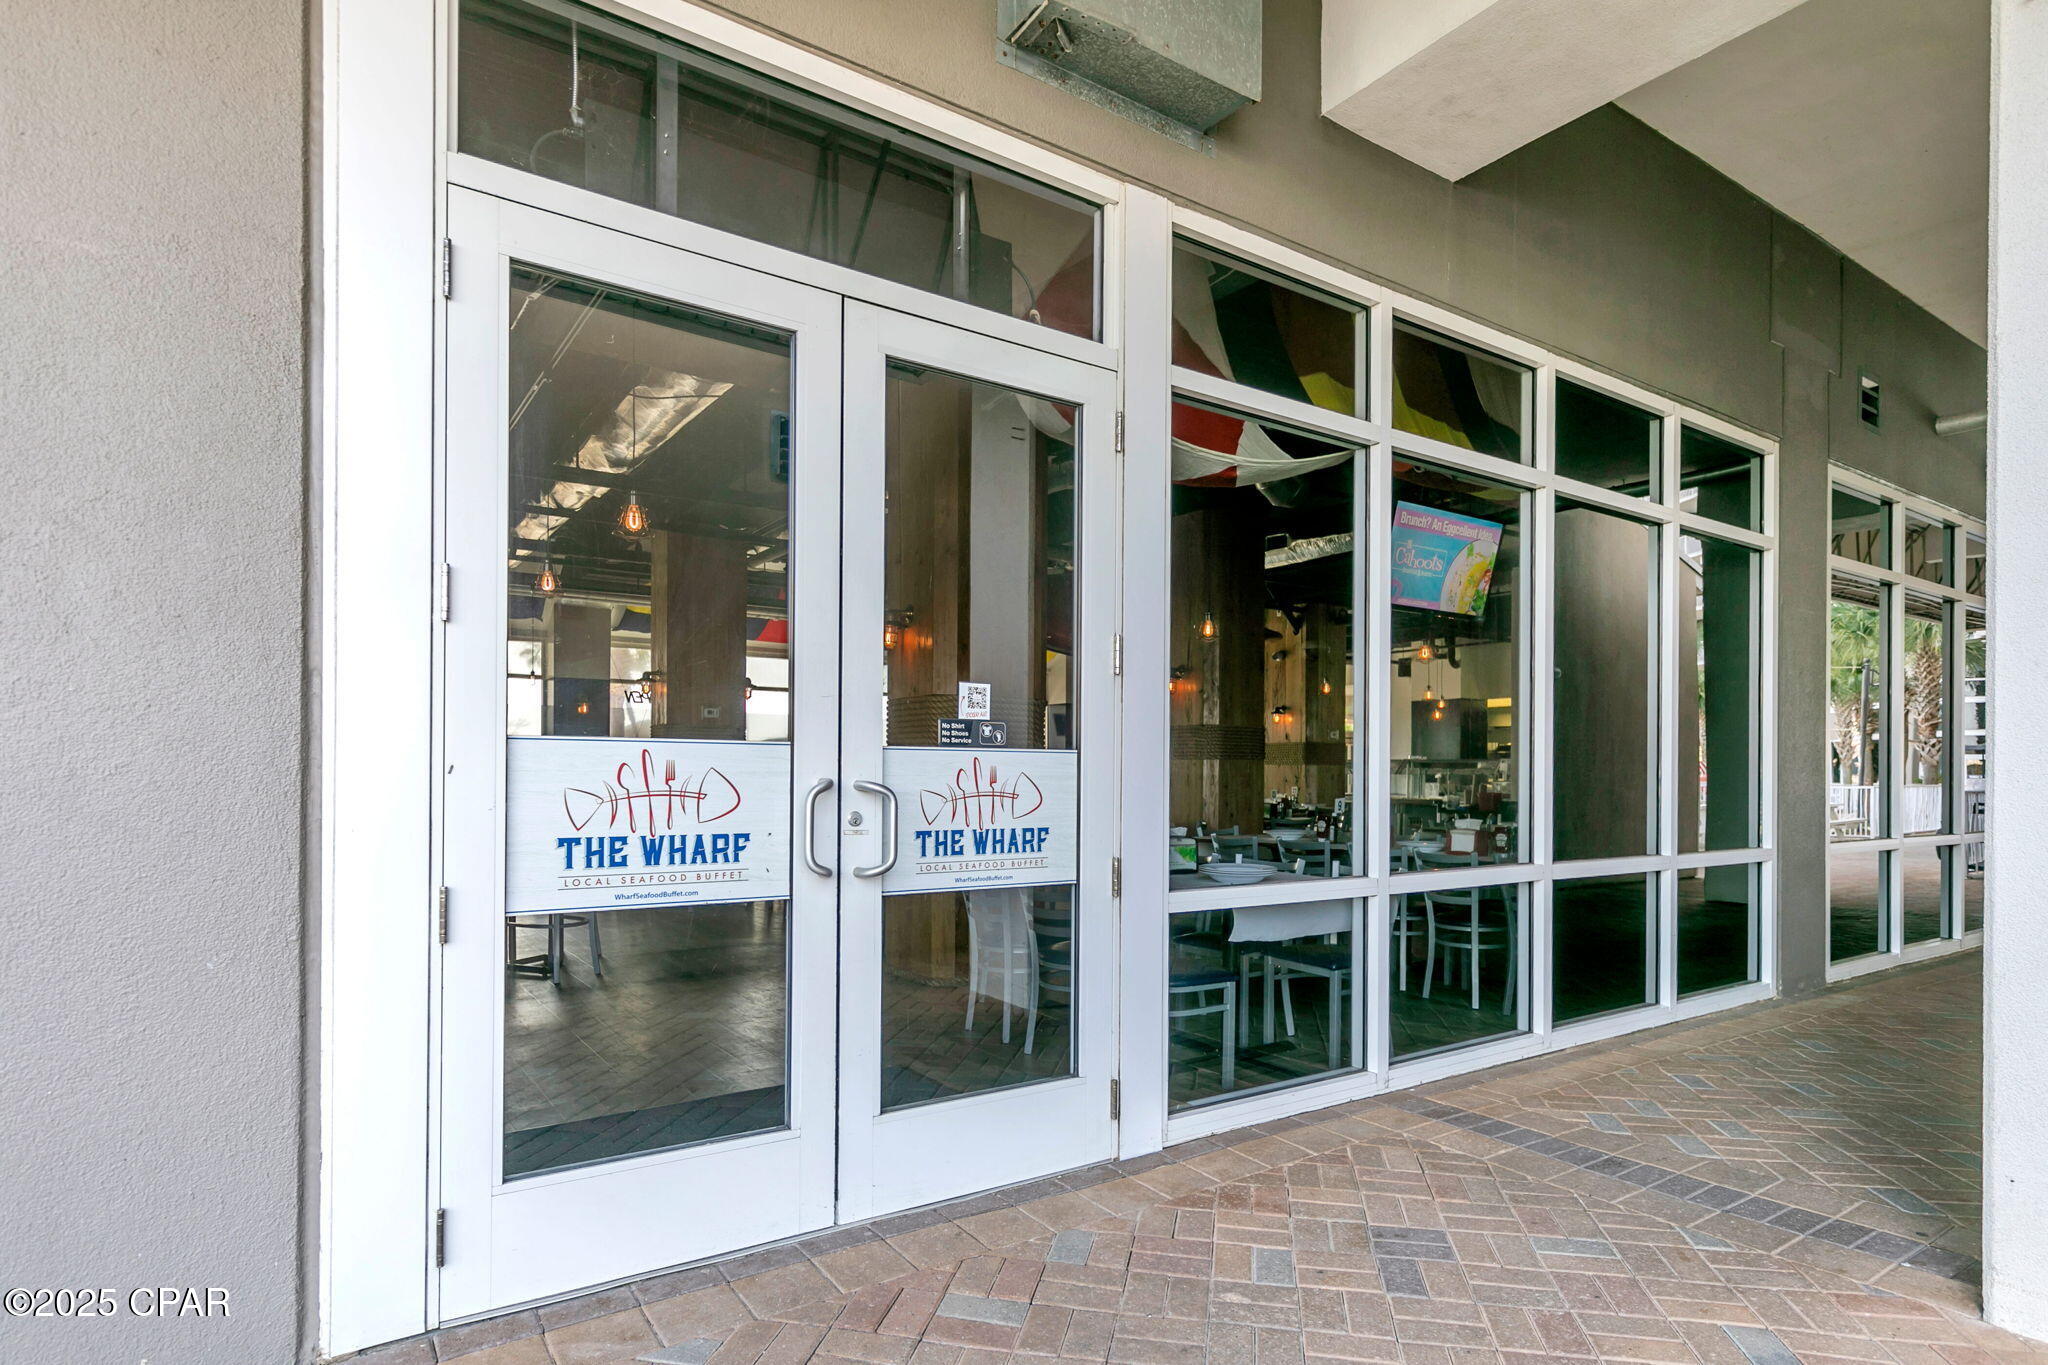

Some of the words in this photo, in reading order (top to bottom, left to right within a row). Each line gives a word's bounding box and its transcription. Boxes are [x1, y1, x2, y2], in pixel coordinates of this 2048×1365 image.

[1400, 511, 1431, 529] Brunch?
[1432, 518, 1442, 530] An
[1443, 521, 1478, 538] Eggcellent
[915, 829, 965, 857] THE
[972, 827, 1050, 854] WHARF
[557, 836, 629, 870] THE
[640, 833, 751, 866] WHARF
[920, 864, 953, 872] LOCAL
[959, 861, 1005, 870] SEAFOOD
[1011, 859, 1044, 867] BUFFET
[564, 876, 611, 888] LOCAL
[621, 873, 687, 884] SEAFOOD
[696, 871, 743, 881] BUFFET
[954, 875, 1014, 884] WharfSeafoodBuffet.com
[614, 889, 699, 901] WharfSeafoodBuffet.com
